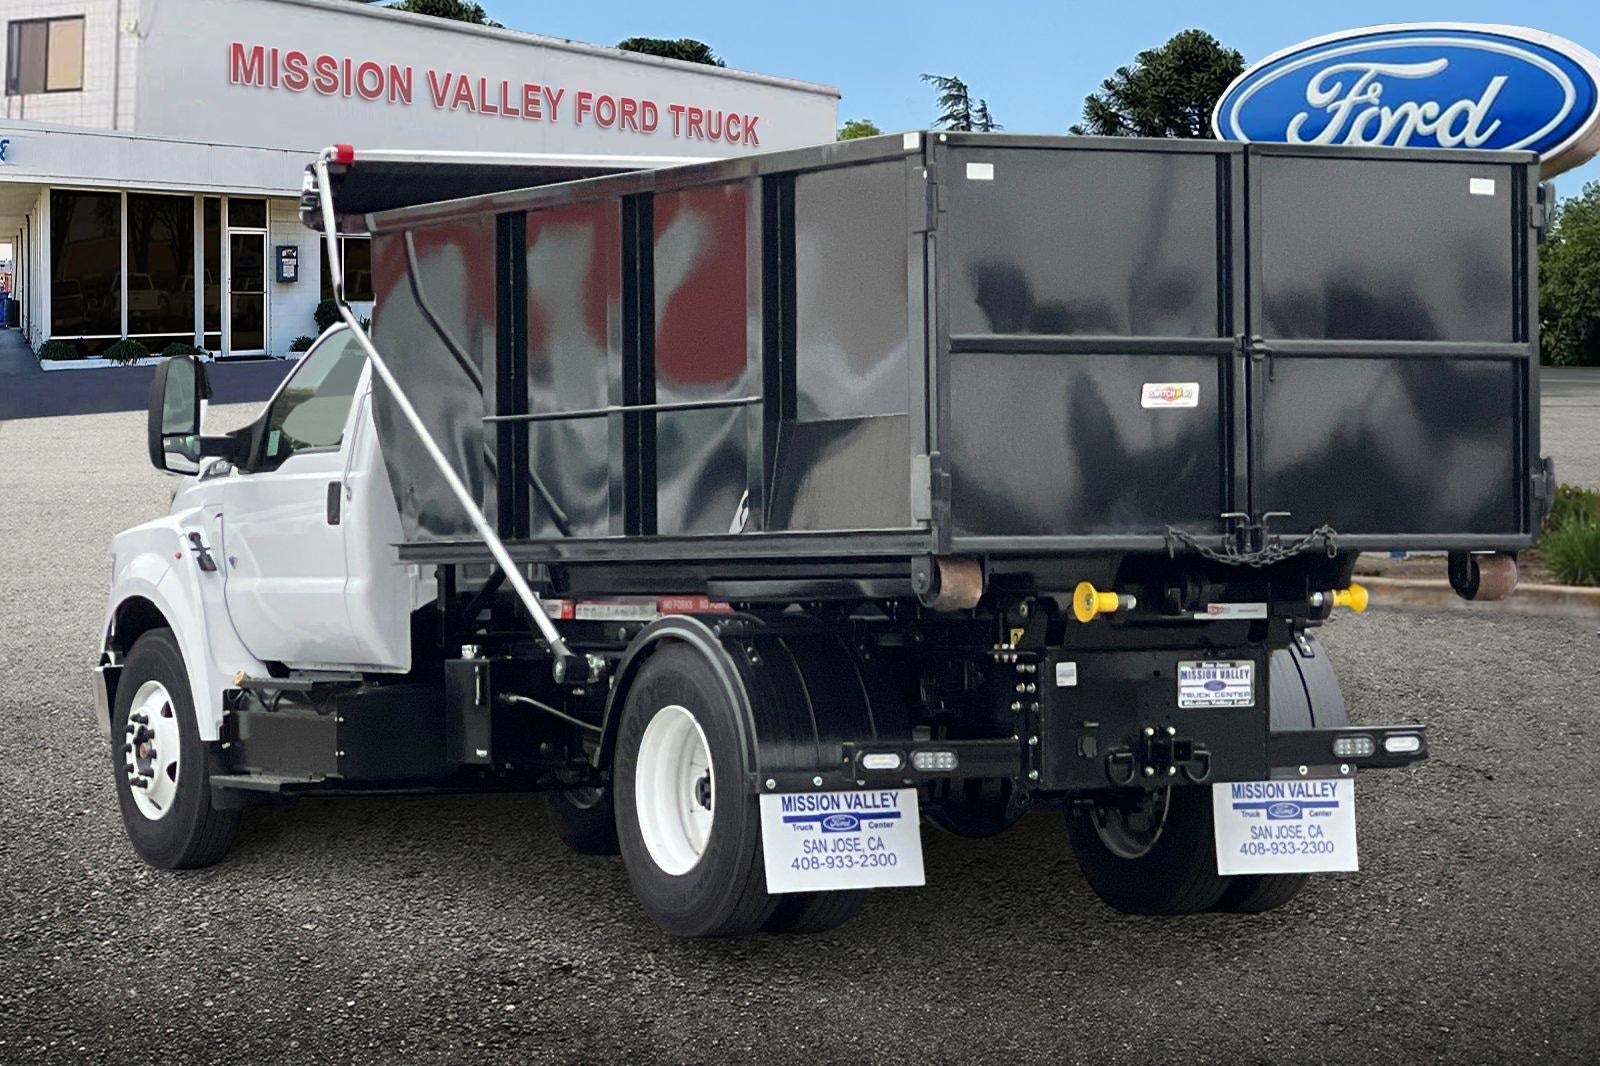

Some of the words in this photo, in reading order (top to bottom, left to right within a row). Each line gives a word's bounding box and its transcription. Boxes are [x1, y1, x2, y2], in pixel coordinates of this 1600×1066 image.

[230, 42, 413, 104] MISSION
[427, 69, 565, 122] VALLEY
[576, 90, 659, 133] FORD
[669, 104, 761, 146] TRUCK
[1286, 58, 1509, 148] Ford
[1180, 669, 1217, 680] MISSION
[1219, 669, 1249, 680] VALLEY
[1214, 691, 1250, 699] CENTER
[1231, 783, 1285, 799] MISSION
[1289, 782, 1338, 798] VALLEY
[781, 794, 840, 812] MISSION
[844, 792, 899, 809] VALLEY
[792, 823, 814, 832] Truck
[868, 821, 894, 830] Center
[1250, 826, 1273, 840] SAN
[1275, 825, 1306, 840] JOSE,
[1307, 824, 1324, 838] CA
[803, 838, 828, 854] SAN
[831, 837, 865, 853] JOSE,
[867, 836, 885, 851] CA
[1240, 841, 1334, 855] 408-933-2300
[791, 852, 897, 871] 408-933-2300
